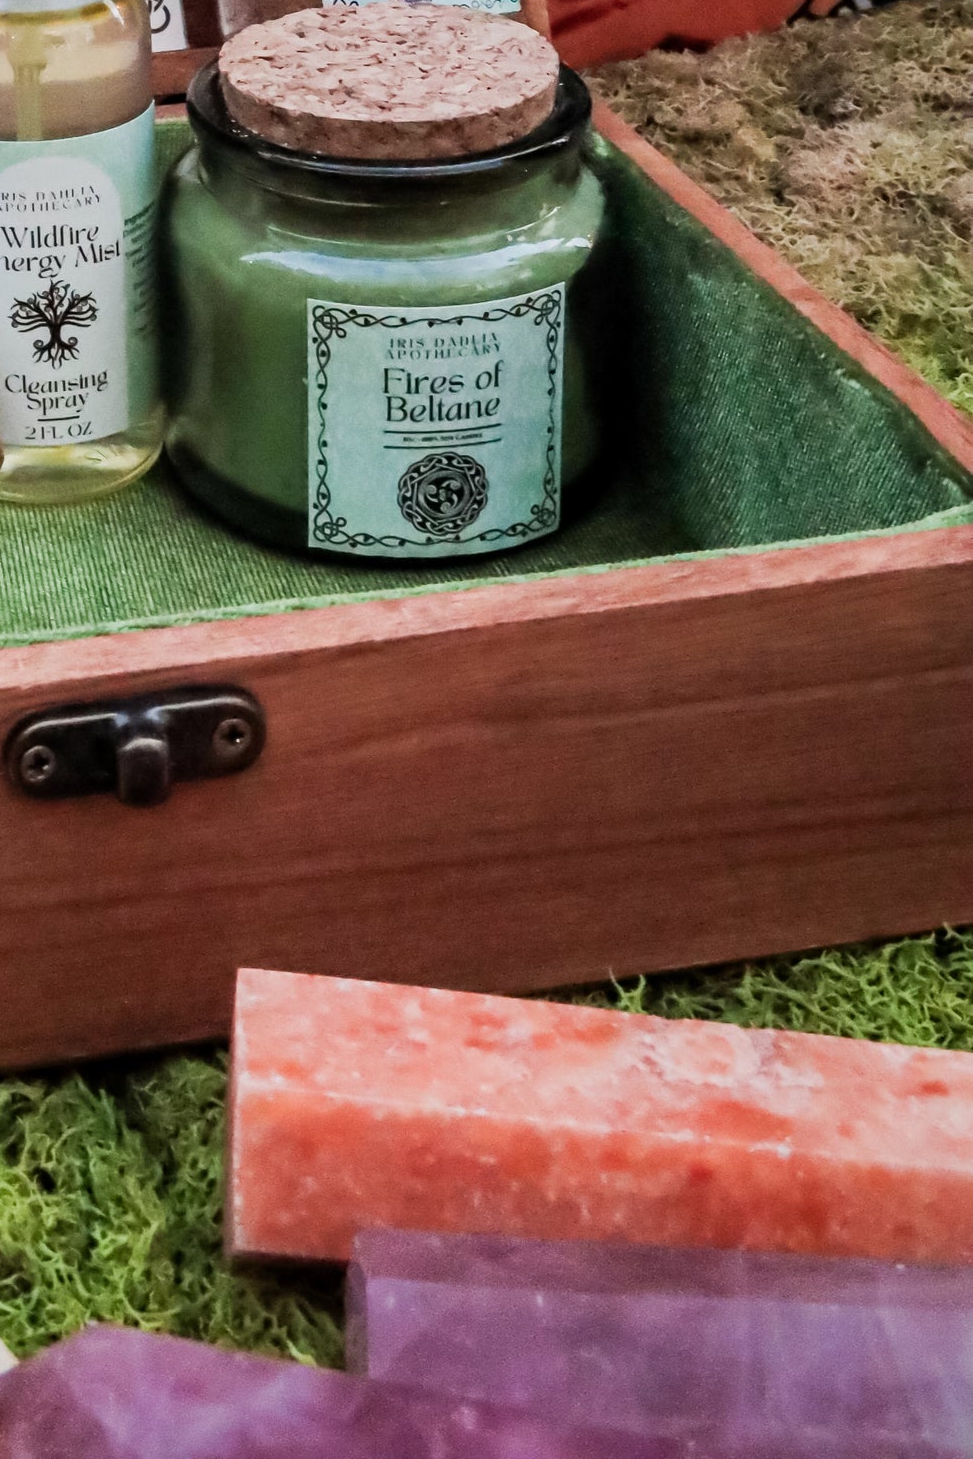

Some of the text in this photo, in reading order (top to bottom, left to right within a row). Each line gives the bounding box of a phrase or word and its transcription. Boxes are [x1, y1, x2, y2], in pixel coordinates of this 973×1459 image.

[35, 185, 95, 201] DAHLIA
[0, 224, 99, 249] Wildfire
[75, 239, 121, 268] Mist
[386, 343, 500, 360] APOTHECARY
[390, 332, 497, 349] IRIS DAHLIA
[5, 370, 108, 394] Cleansing
[383, 359, 504, 394] Fires of
[26, 393, 89, 416] Spray
[386, 394, 501, 423] Beltane
[25, 426, 36, 440] 2
[67, 421, 93, 438] OZ
